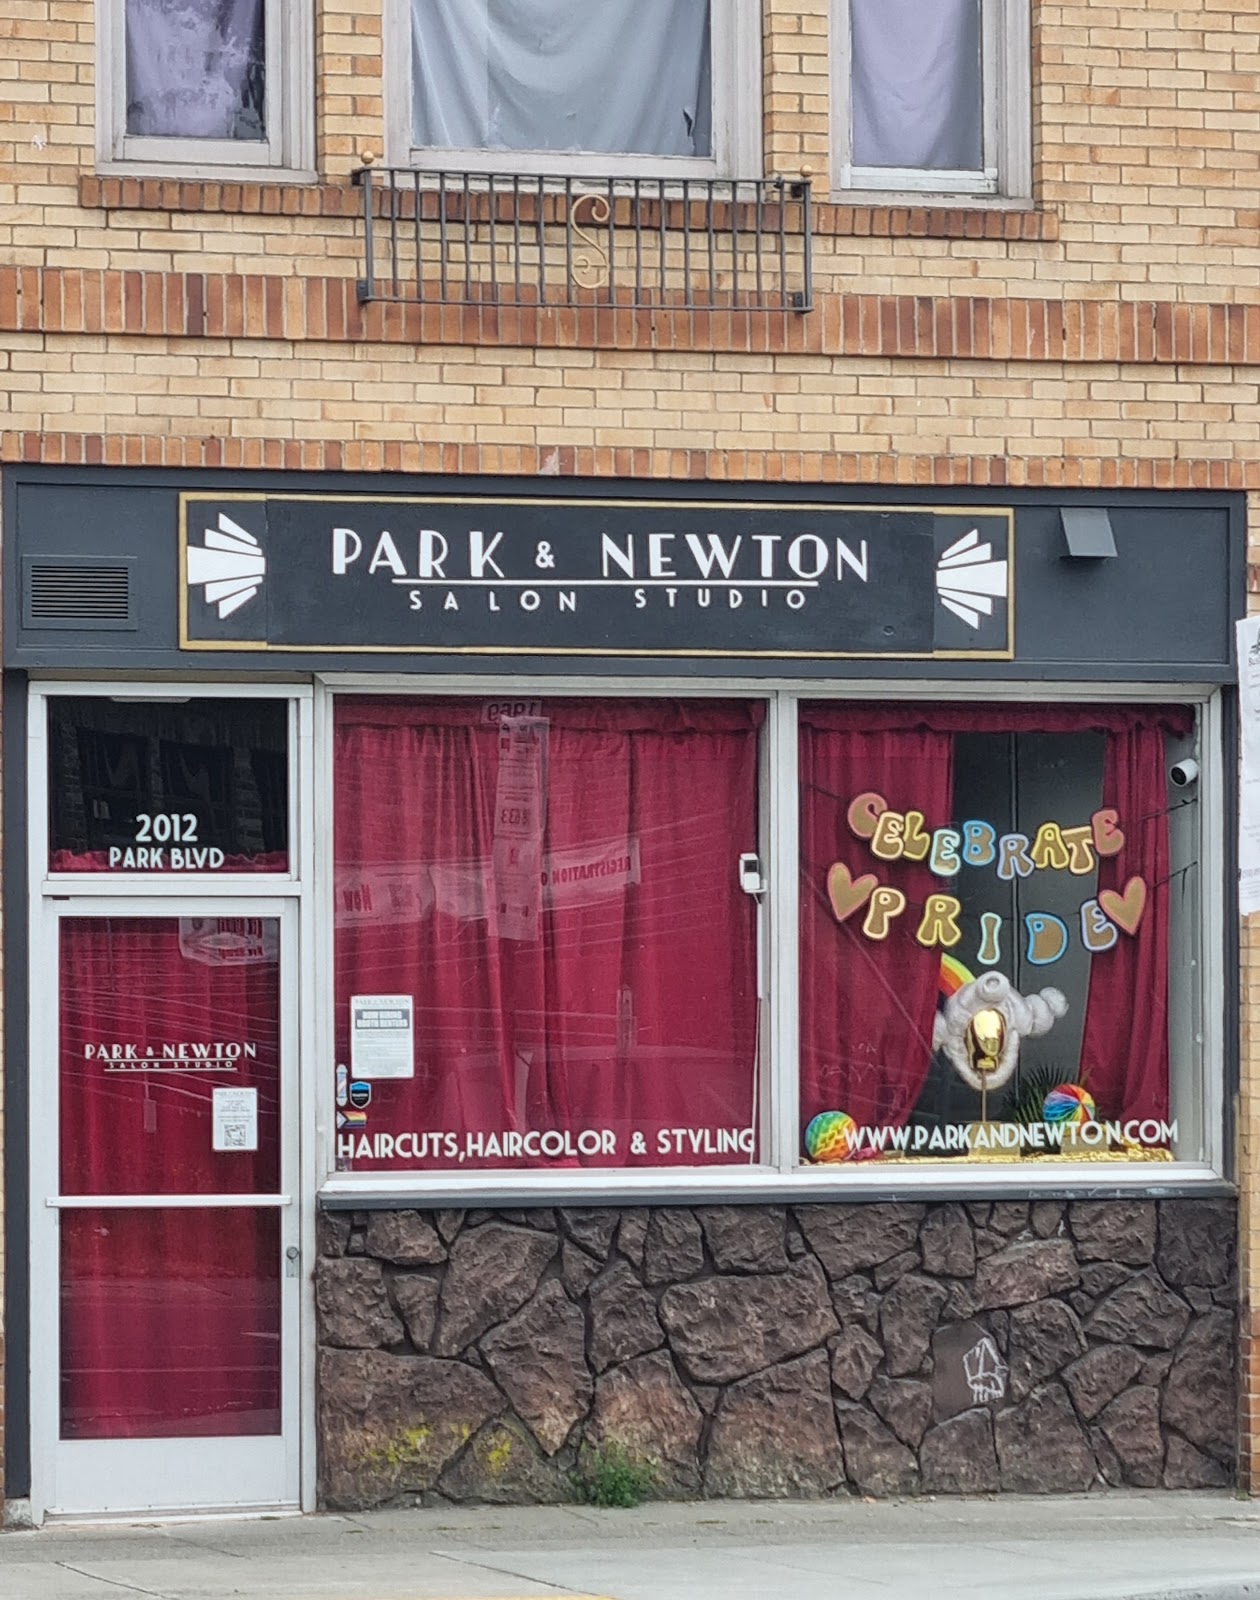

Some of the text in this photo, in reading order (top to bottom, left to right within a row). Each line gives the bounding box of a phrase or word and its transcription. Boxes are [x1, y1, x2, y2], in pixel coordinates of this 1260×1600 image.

[332, 527, 868, 583] PARK & NEWTON
[409, 588, 806, 612] SALON STUDIO
[135, 813, 198, 842] 2012
[847, 791, 1125, 881] CELEBRATE
[109, 846, 225, 870] PARK BLVD
[862, 887, 1118, 965] PRIDE
[84, 1042, 257, 1060] PARK & NEWTON
[109, 1060, 233, 1069] SALON STUDIO
[630, 1131, 648, 1155] &
[657, 1127, 755, 1155] STYLING
[844, 1118, 1179, 1151] WWW.PARKANDNEWTON.COM
